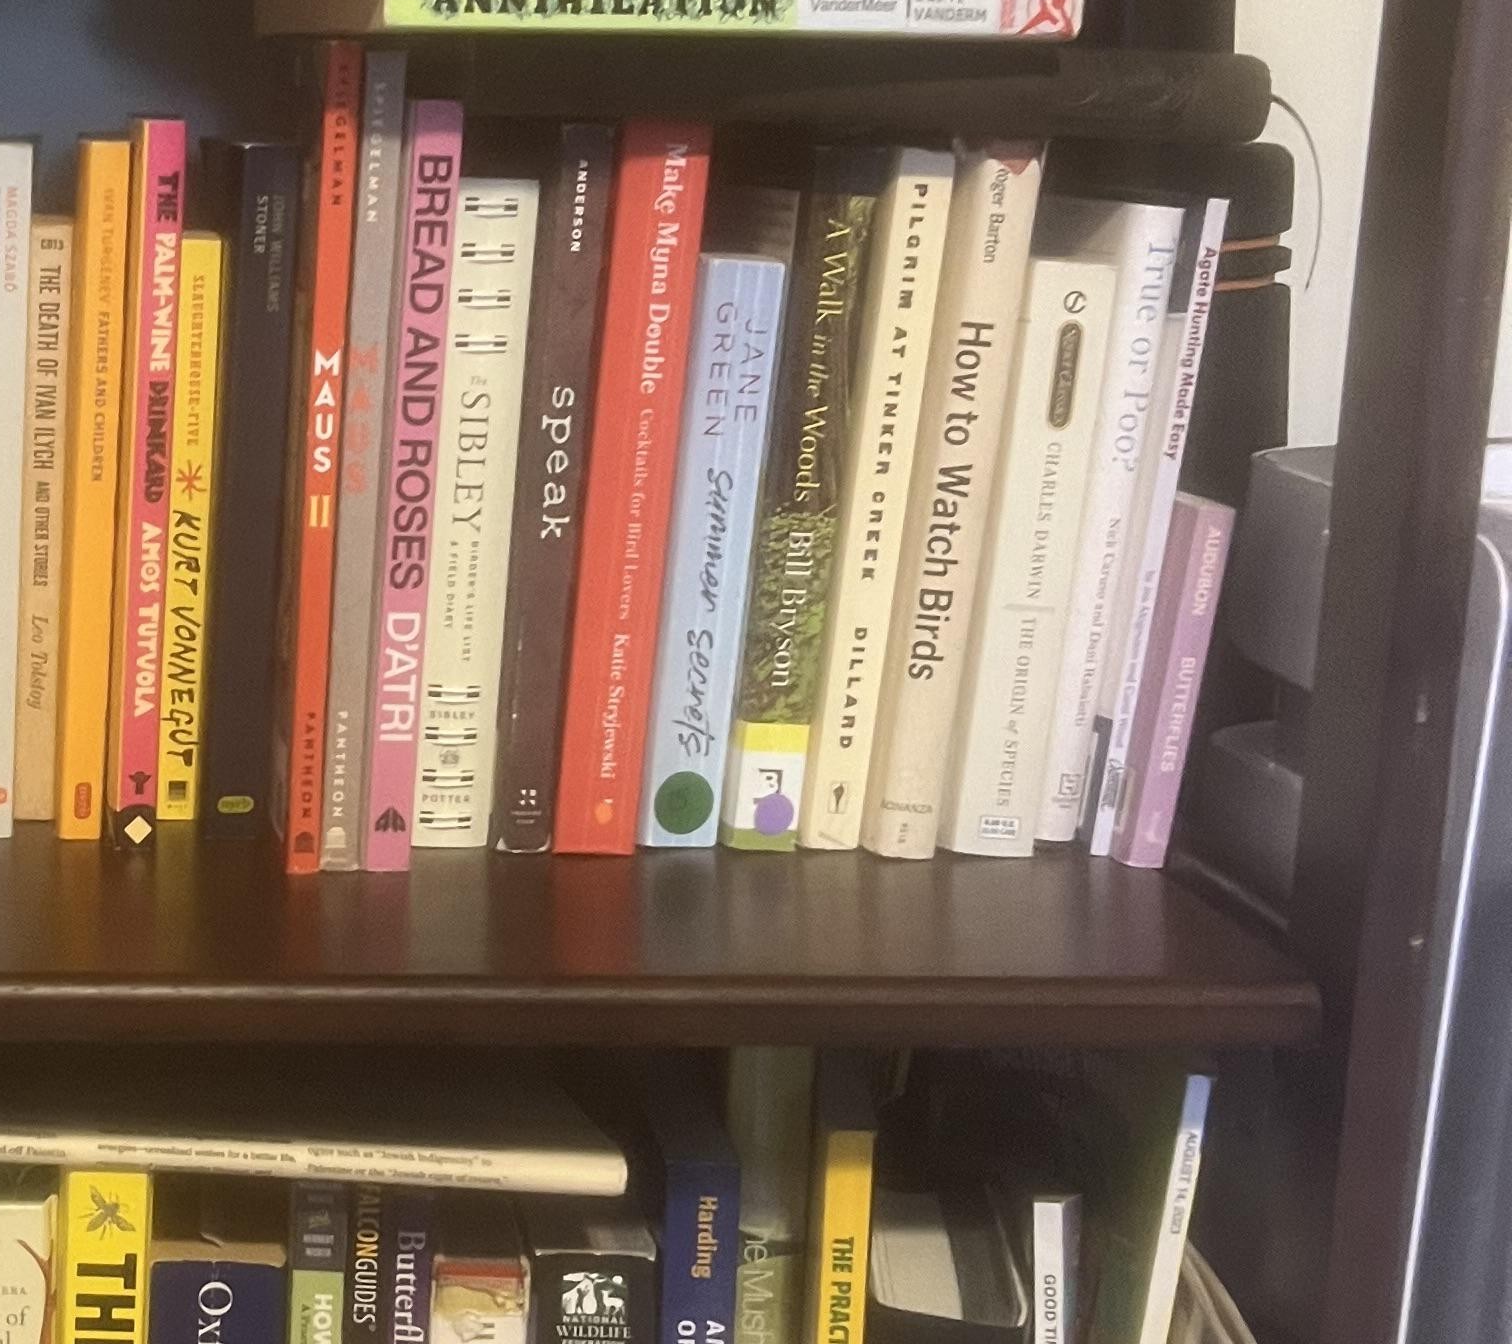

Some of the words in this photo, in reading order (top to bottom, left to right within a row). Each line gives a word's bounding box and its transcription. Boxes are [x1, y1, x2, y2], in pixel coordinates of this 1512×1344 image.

[913, 5, 988, 24] VANDERM
[157, 169, 180, 224] THE
[408, 154, 454, 316] BREAD
[39, 264, 62, 288] THE
[148, 231, 178, 374] PALM-WINE
[1194, 246, 1218, 298] Agate
[37, 290, 62, 353] DEATH
[1183, 299, 1209, 368] Hunting
[36, 356, 58, 379] OF
[400, 326, 441, 428] AND
[950, 320, 995, 402] How
[1174, 369, 1191, 412] Made
[35, 385, 57, 420] IVAN
[312, 349, 343, 473] MAUS
[943, 411, 978, 446] to
[32, 422, 55, 471] ILYCH
[142, 380, 171, 504] DRINKARD
[540, 385, 576, 541] speak
[1163, 411, 1185, 462] Easy
[310, 494, 331, 529] II
[389, 439, 433, 591] ROSES
[924, 463, 974, 578] Watch
[138, 520, 163, 593] AMOS
[909, 586, 955, 682] Birds
[379, 610, 421, 743] D'ATRI
[1043, 1273, 1058, 1326] GOOD
